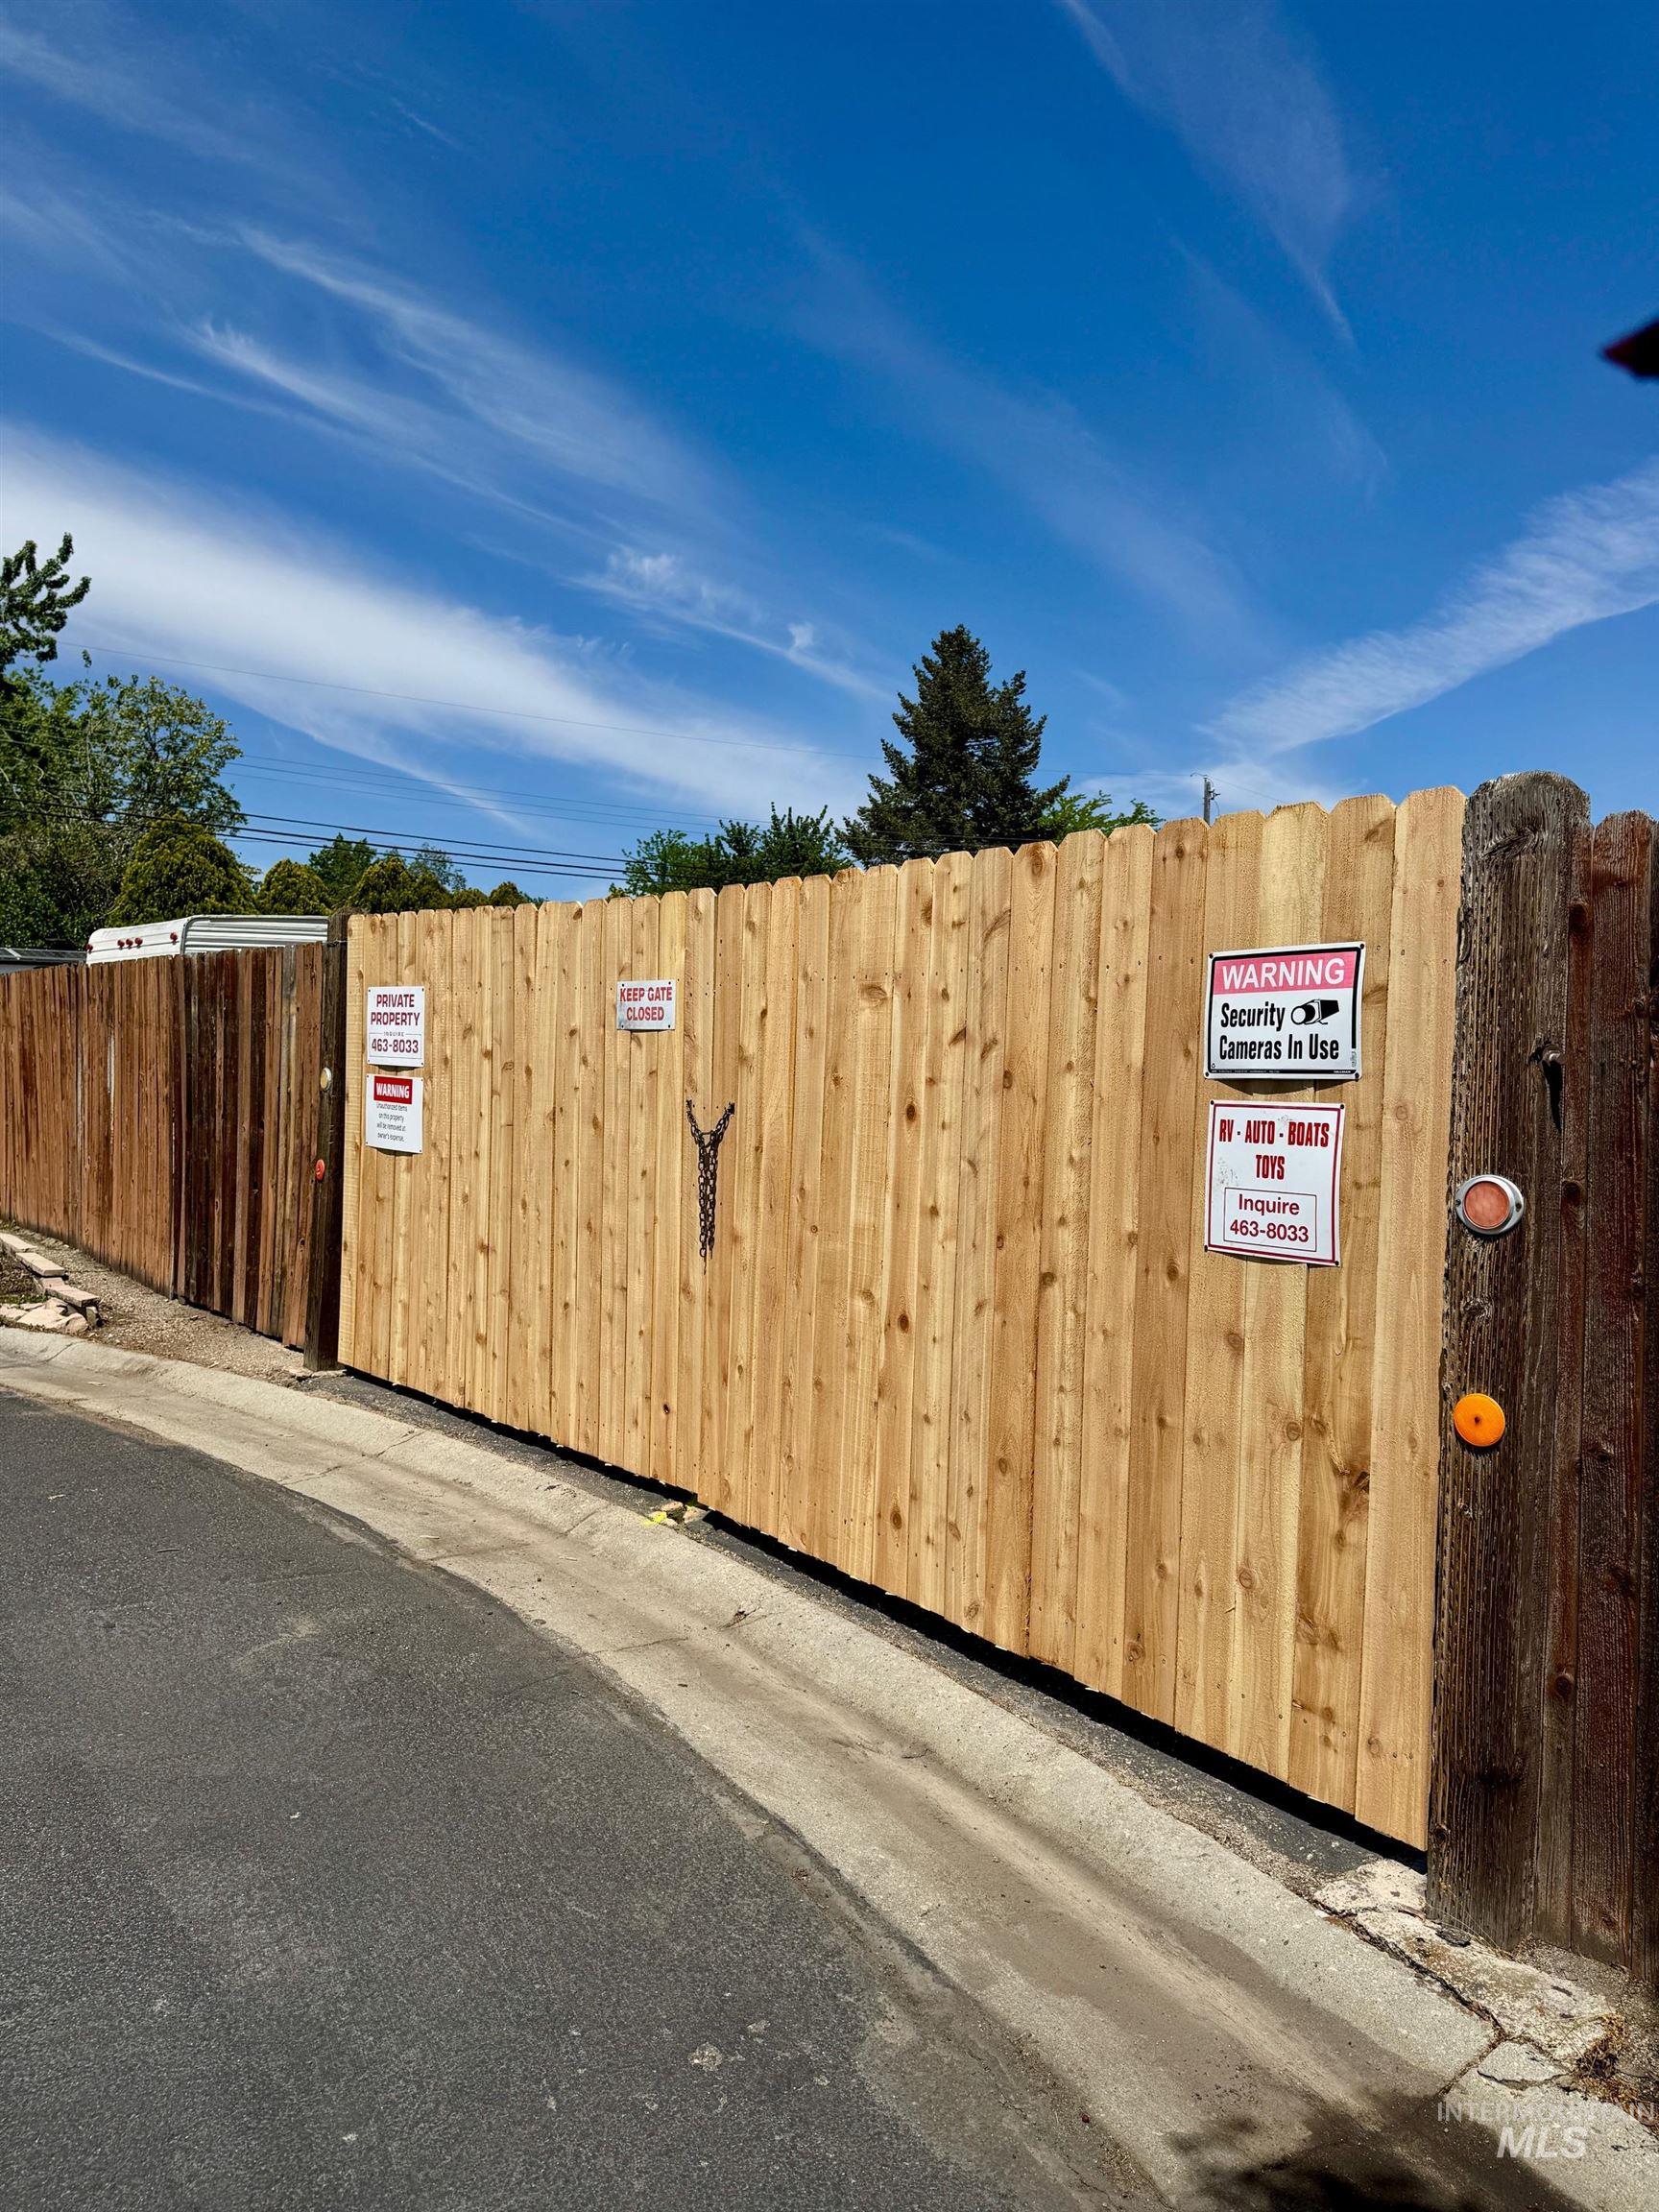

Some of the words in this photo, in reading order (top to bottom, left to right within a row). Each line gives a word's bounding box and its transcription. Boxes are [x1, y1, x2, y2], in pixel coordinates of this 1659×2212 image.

[1222, 957, 1345, 990] WARNING
[375, 994, 415, 1008] PRIVATE
[619, 987, 645, 1001] KEEP
[647, 986, 673, 1001] GATE
[371, 1011, 421, 1026] PROPERTY
[626, 1006, 664, 1021] CLOSED
[1220, 1000, 1286, 1032] Security
[372, 1038, 419, 1053] 463-8033
[1219, 1034, 1282, 1060] Cameras
[1287, 1033, 1303, 1060] In
[1309, 1033, 1339, 1060] Use
[375, 1082, 410, 1098] WARNING
[1218, 1118, 1234, 1142] RV
[1244, 1119, 1276, 1144] AUTO
[1287, 1121, 1330, 1147] BOATS
[1256, 1154, 1286, 1180] TOYS
[1238, 1193, 1300, 1216] Inquire
[1230, 1219, 1310, 1242] 463-8033
